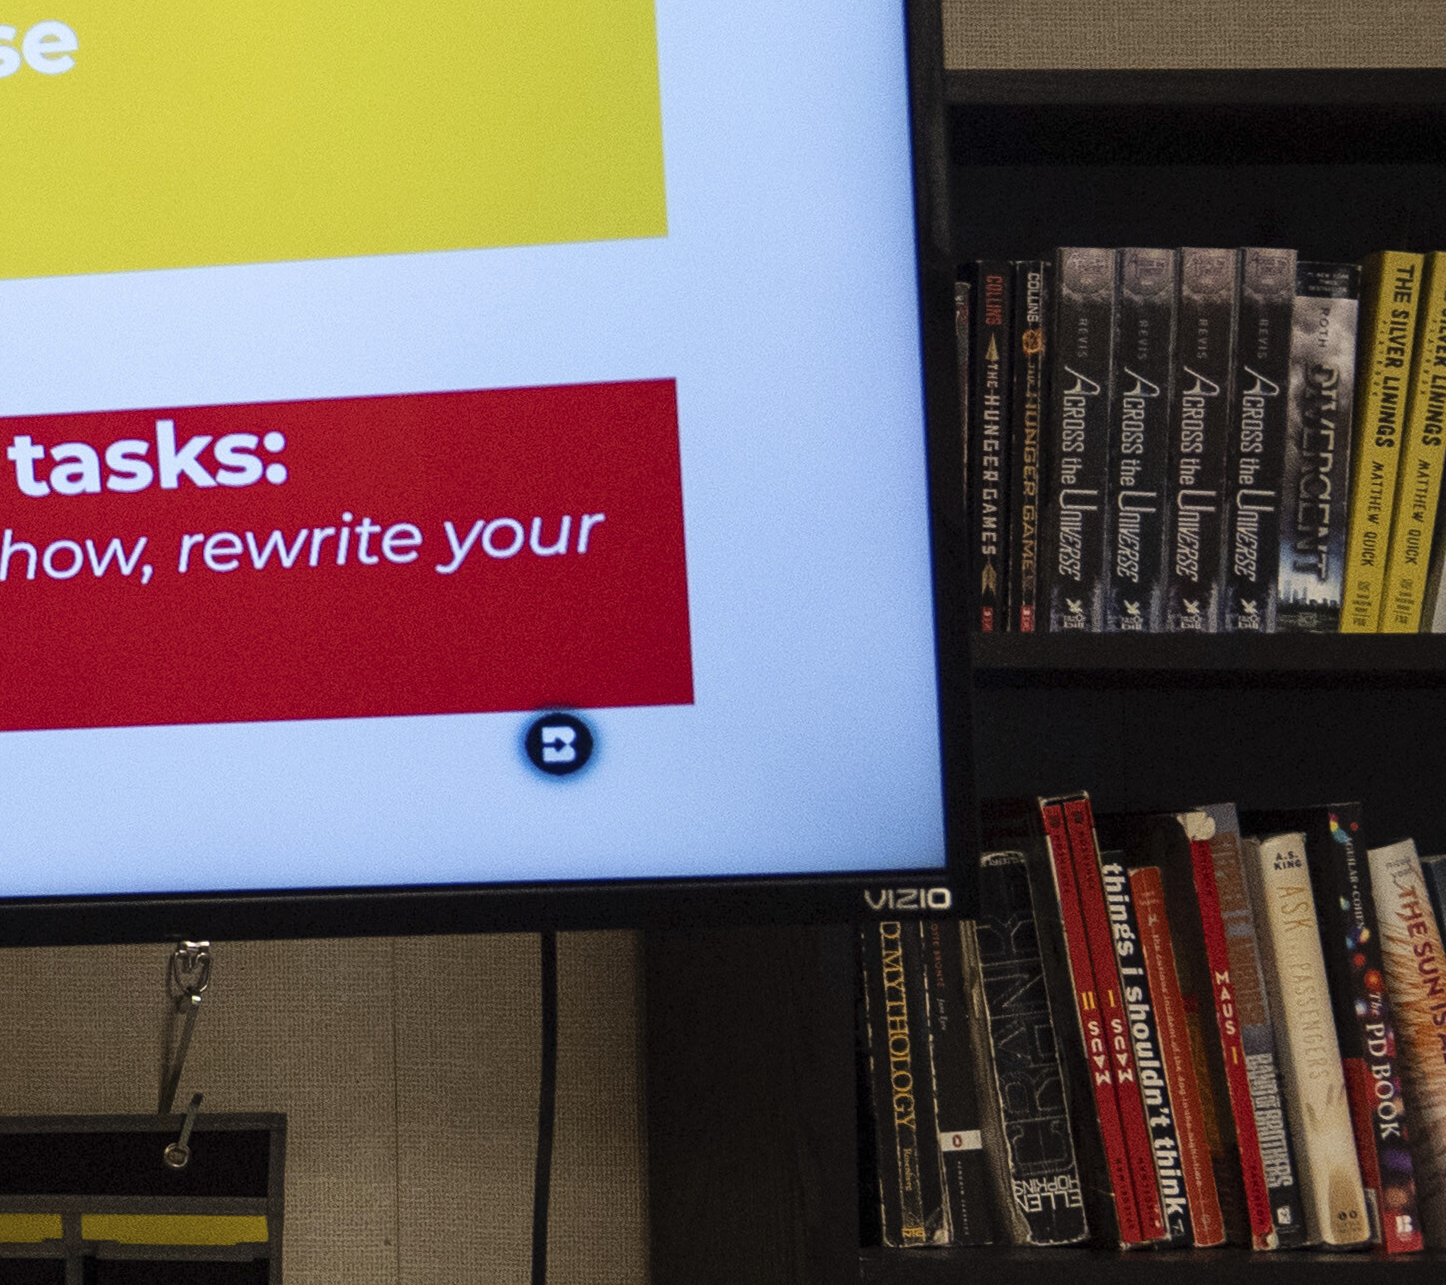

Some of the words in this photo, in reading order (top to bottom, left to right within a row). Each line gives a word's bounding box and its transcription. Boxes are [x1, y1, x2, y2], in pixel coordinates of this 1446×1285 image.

[1394, 266, 1414, 303] THE
[1384, 309, 1410, 368] SILVER
[1375, 376, 1398, 448] LININGS
[6, 419, 287, 497] tasks:
[178, 511, 423, 573] rewrite
[435, 513, 605, 574] your
[865, 887, 952, 910] VIZIO
[1102, 863, 1135, 957] things
[1121, 967, 1143, 975] i
[882, 948, 914, 1127] MYTHOLOGY
[1126, 986, 1171, 1127] shouldn't
[1366, 1022, 1387, 1057] PD
[1371, 1063, 1400, 1140] BOOK
[1155, 1137, 1187, 1215] think
